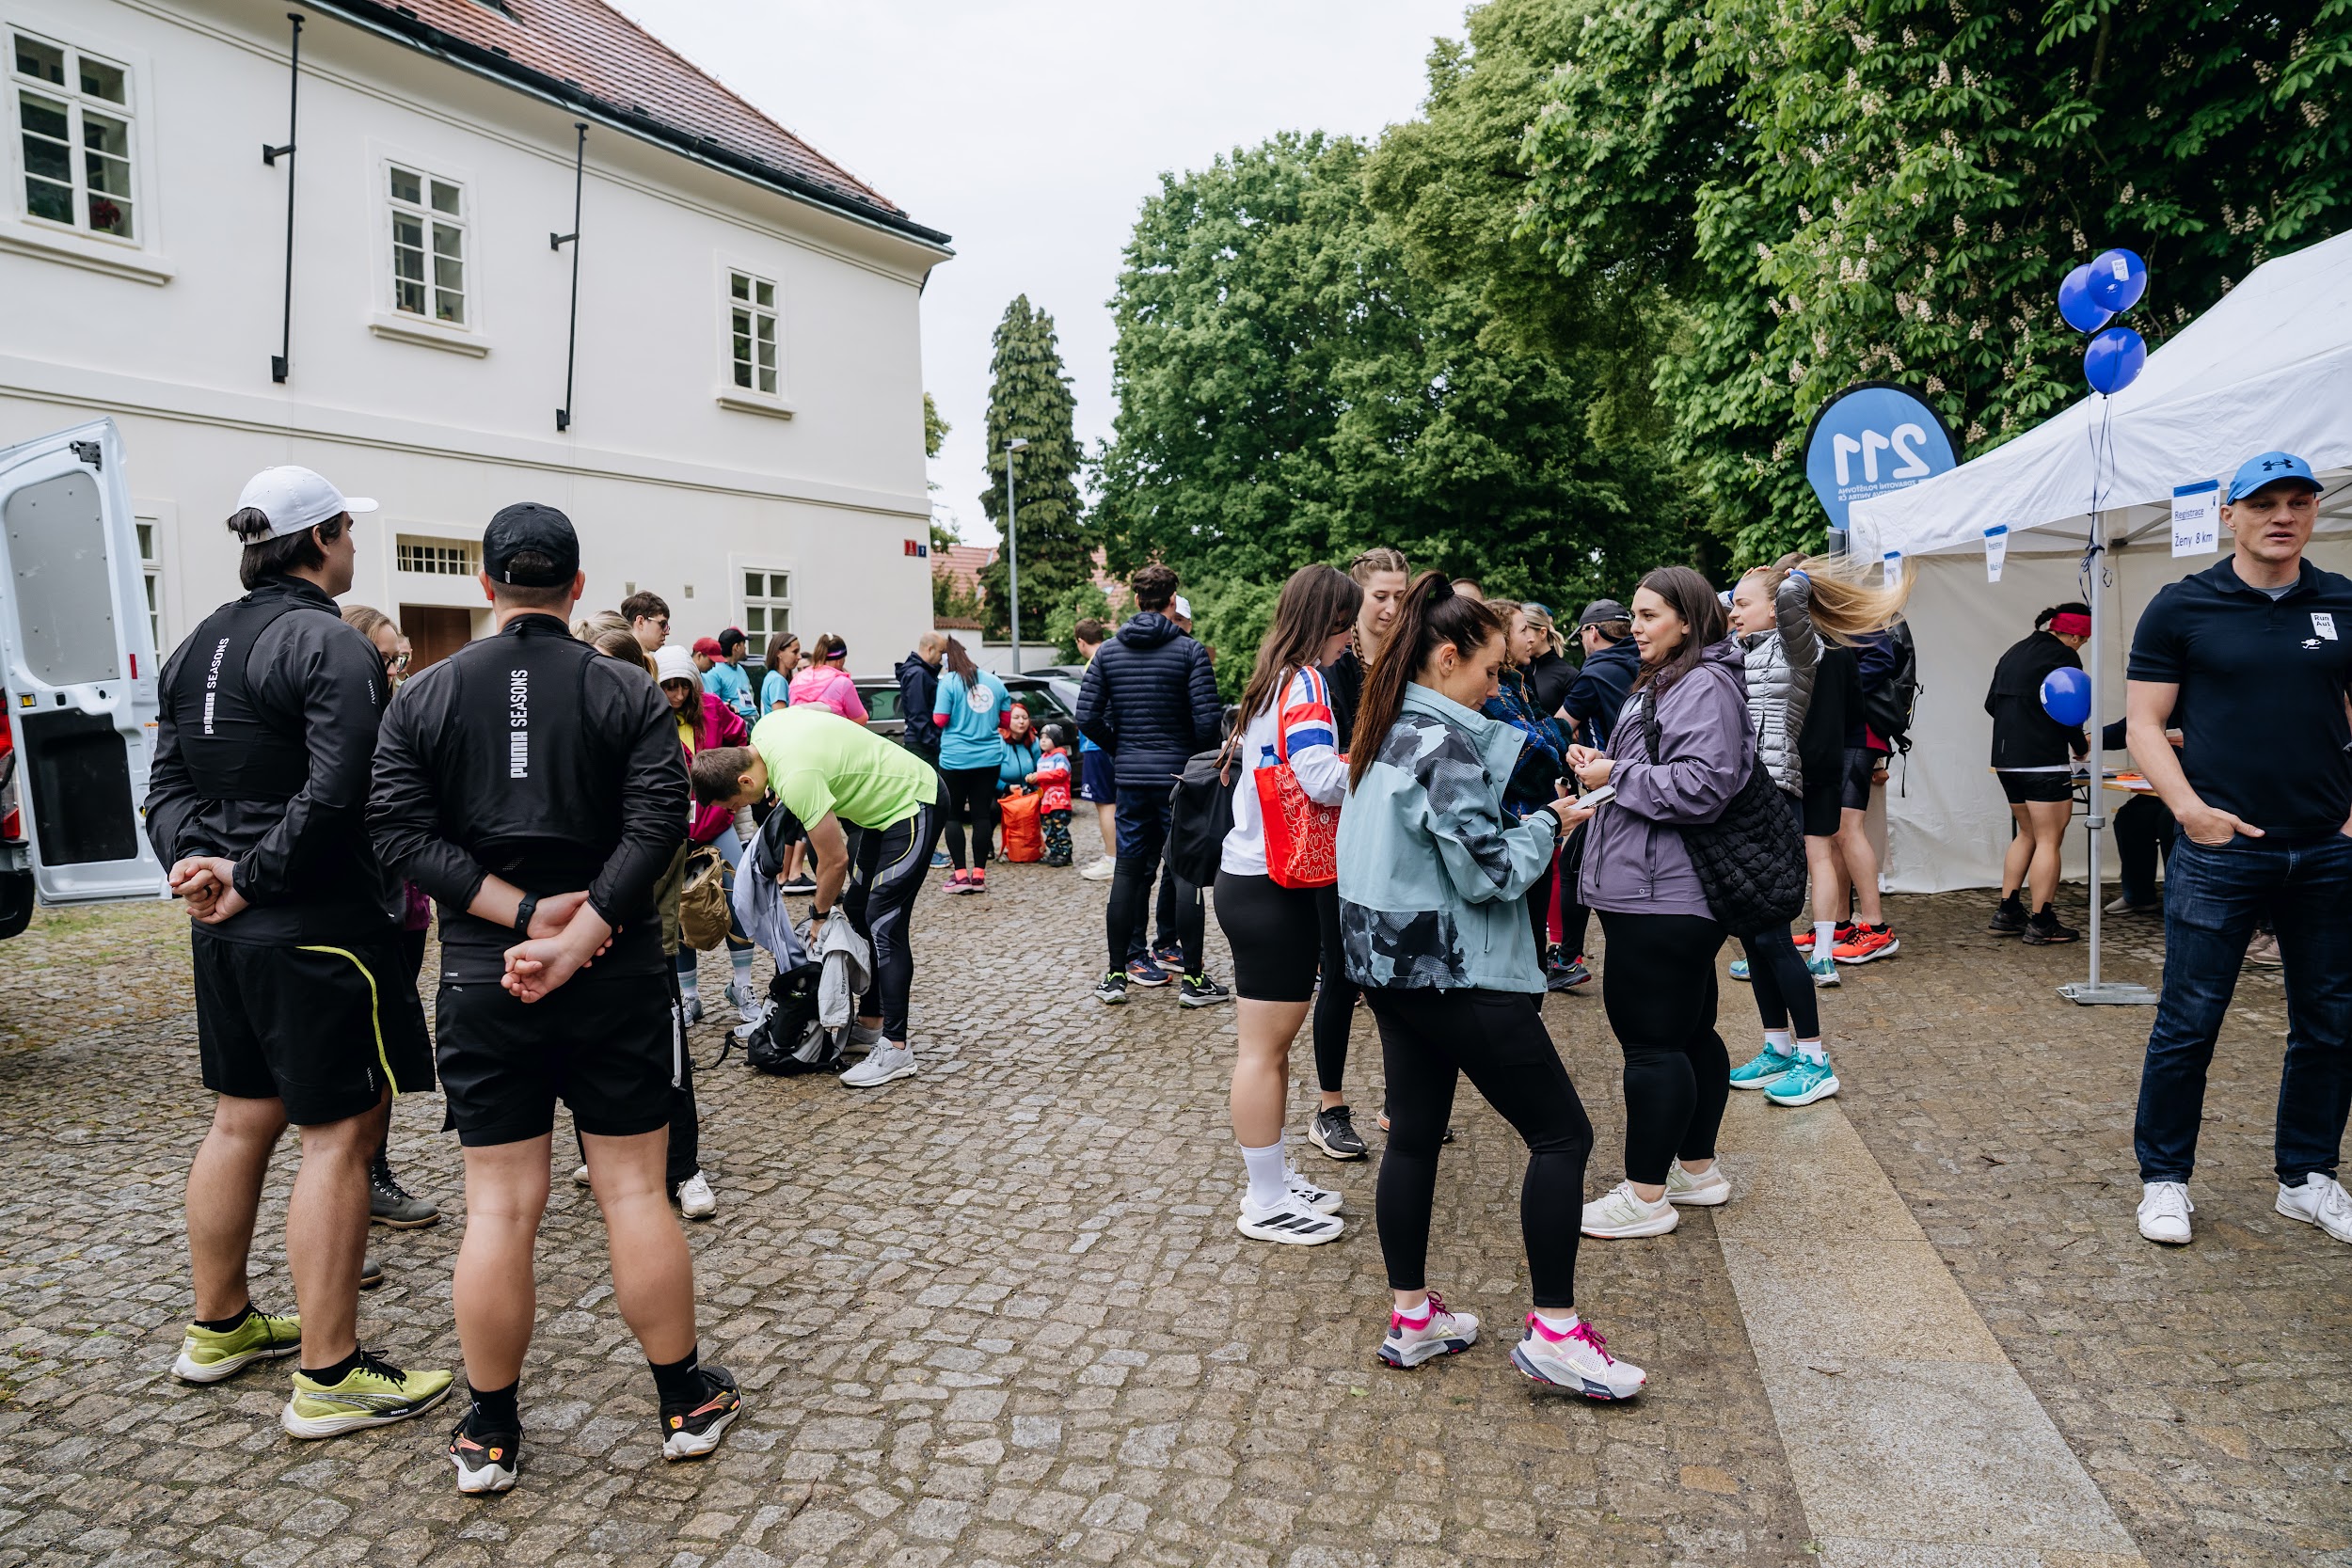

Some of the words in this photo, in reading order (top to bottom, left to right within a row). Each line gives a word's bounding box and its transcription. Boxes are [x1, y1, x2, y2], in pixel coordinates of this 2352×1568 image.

[2175, 508, 2204, 520] Registrace
[2175, 532, 2193, 547] Ženy
[2195, 532, 2200, 544] 8
[2202, 531, 2213, 543] km
[207, 637, 230, 689] SEASONS
[510, 669, 528, 727] SEASONS
[510, 731, 528, 778] PUMA
